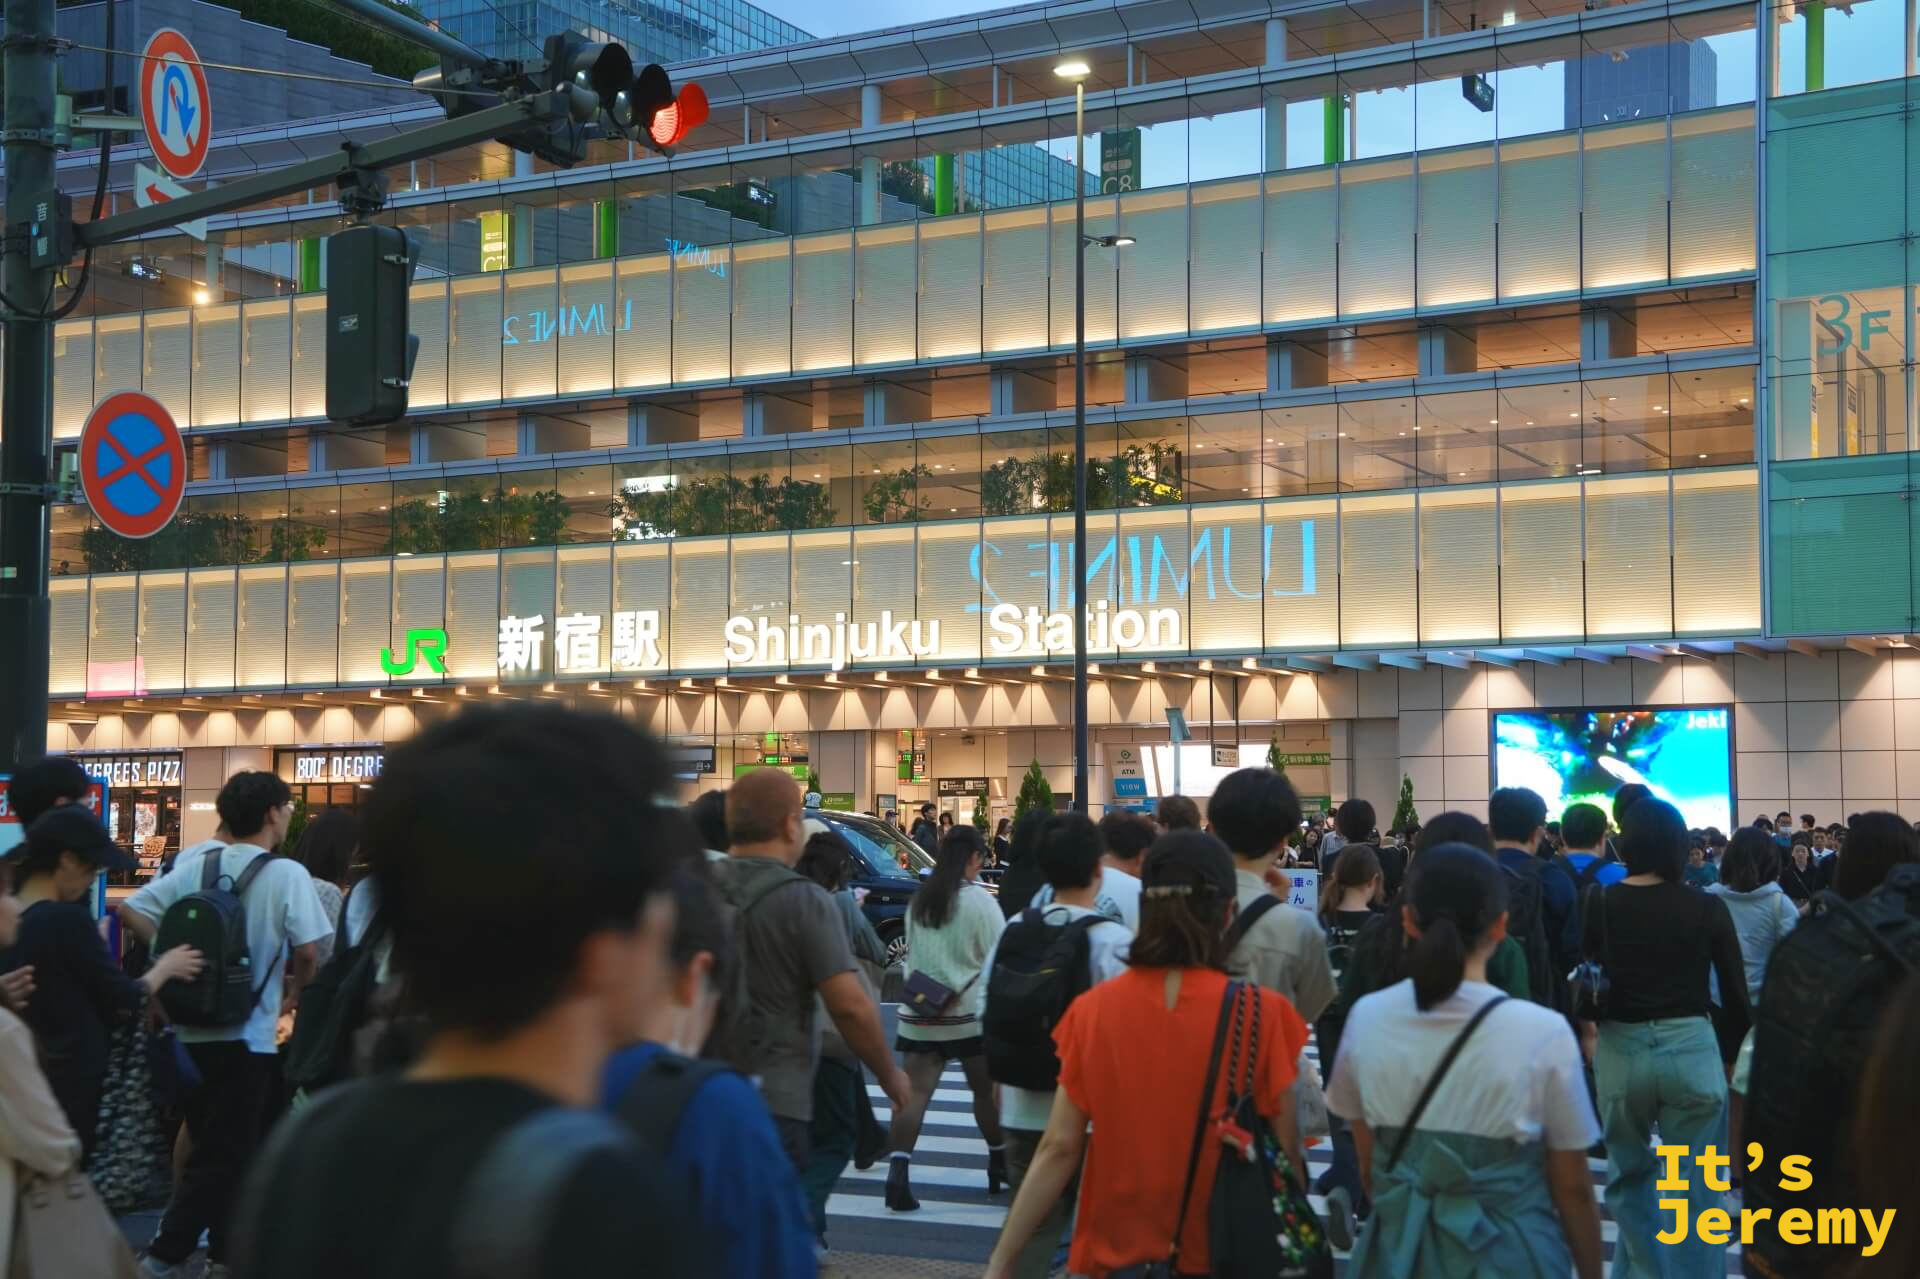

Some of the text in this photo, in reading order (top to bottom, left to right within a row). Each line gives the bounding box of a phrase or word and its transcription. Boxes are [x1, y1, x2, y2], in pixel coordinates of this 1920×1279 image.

[1818, 294, 1891, 356] 3F
[380, 628, 447, 676] JR
[498, 610, 662, 674] 新宿駅
[724, 599, 1182, 671] Shinjuku Station
[147, 760, 184, 782] PIZZ
[1121, 768, 1136, 776] ATM
[1289, 877, 1314, 888] 車の
